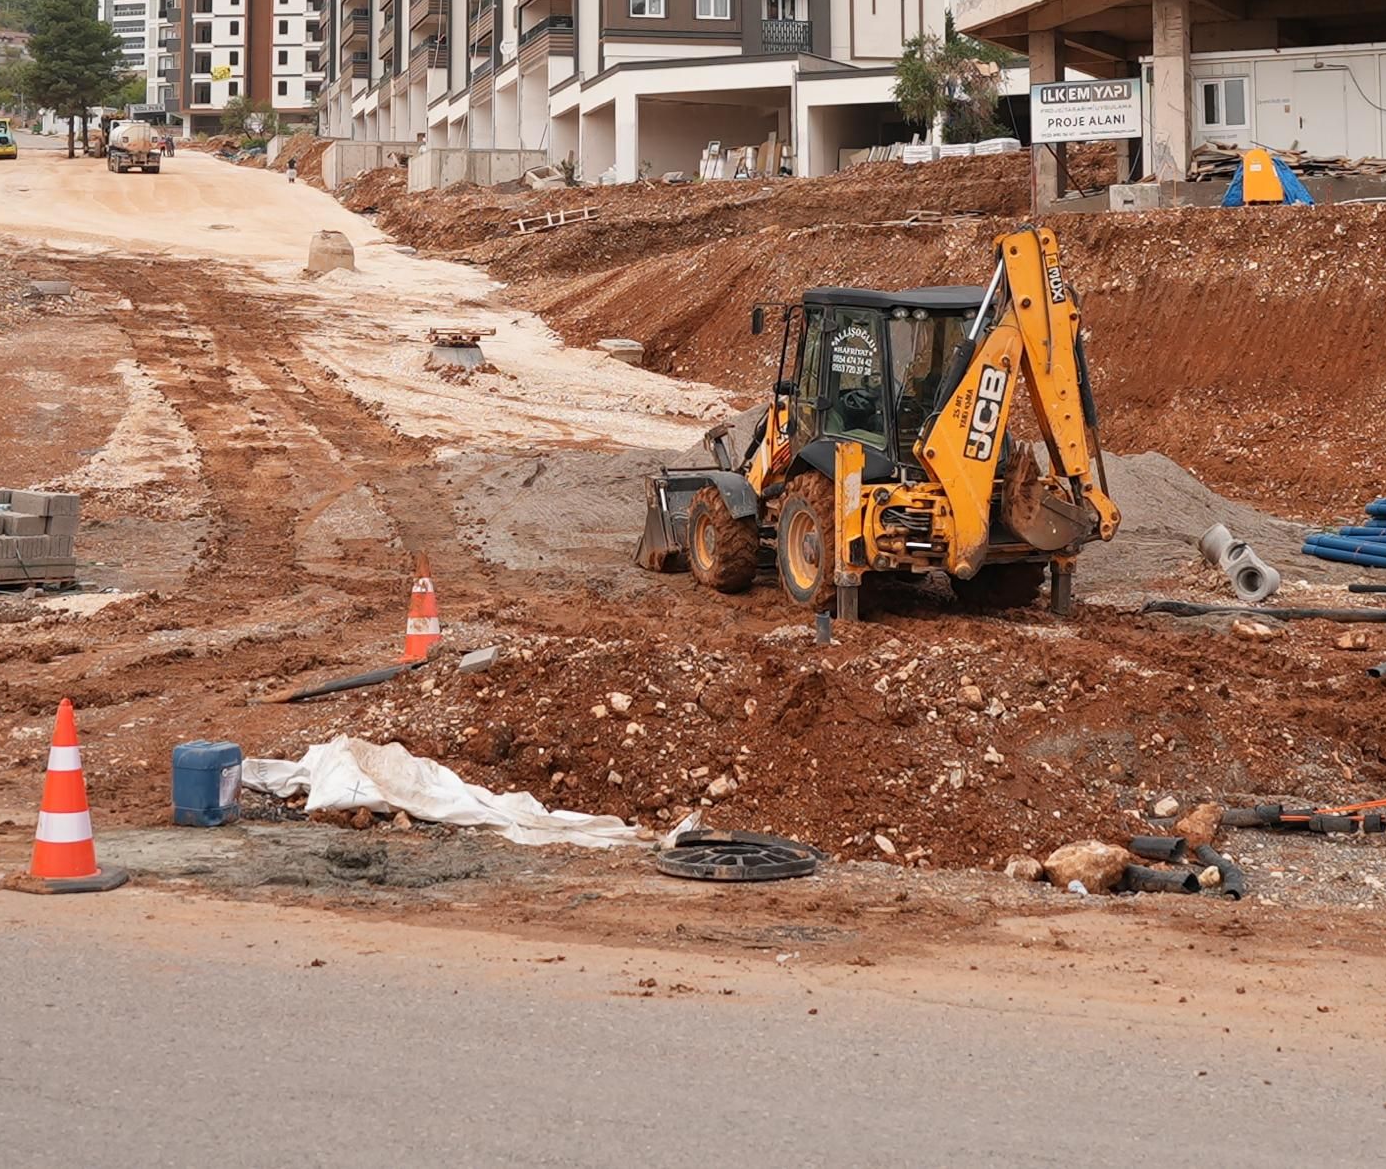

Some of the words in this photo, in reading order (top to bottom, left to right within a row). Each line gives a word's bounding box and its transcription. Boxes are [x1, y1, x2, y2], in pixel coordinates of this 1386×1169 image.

[1093, 84, 1128, 99] YAPI
[1047, 116, 1085, 128] PROJE
[1089, 114, 1125, 126] ALANI
[968, 367, 1007, 460] JCB
